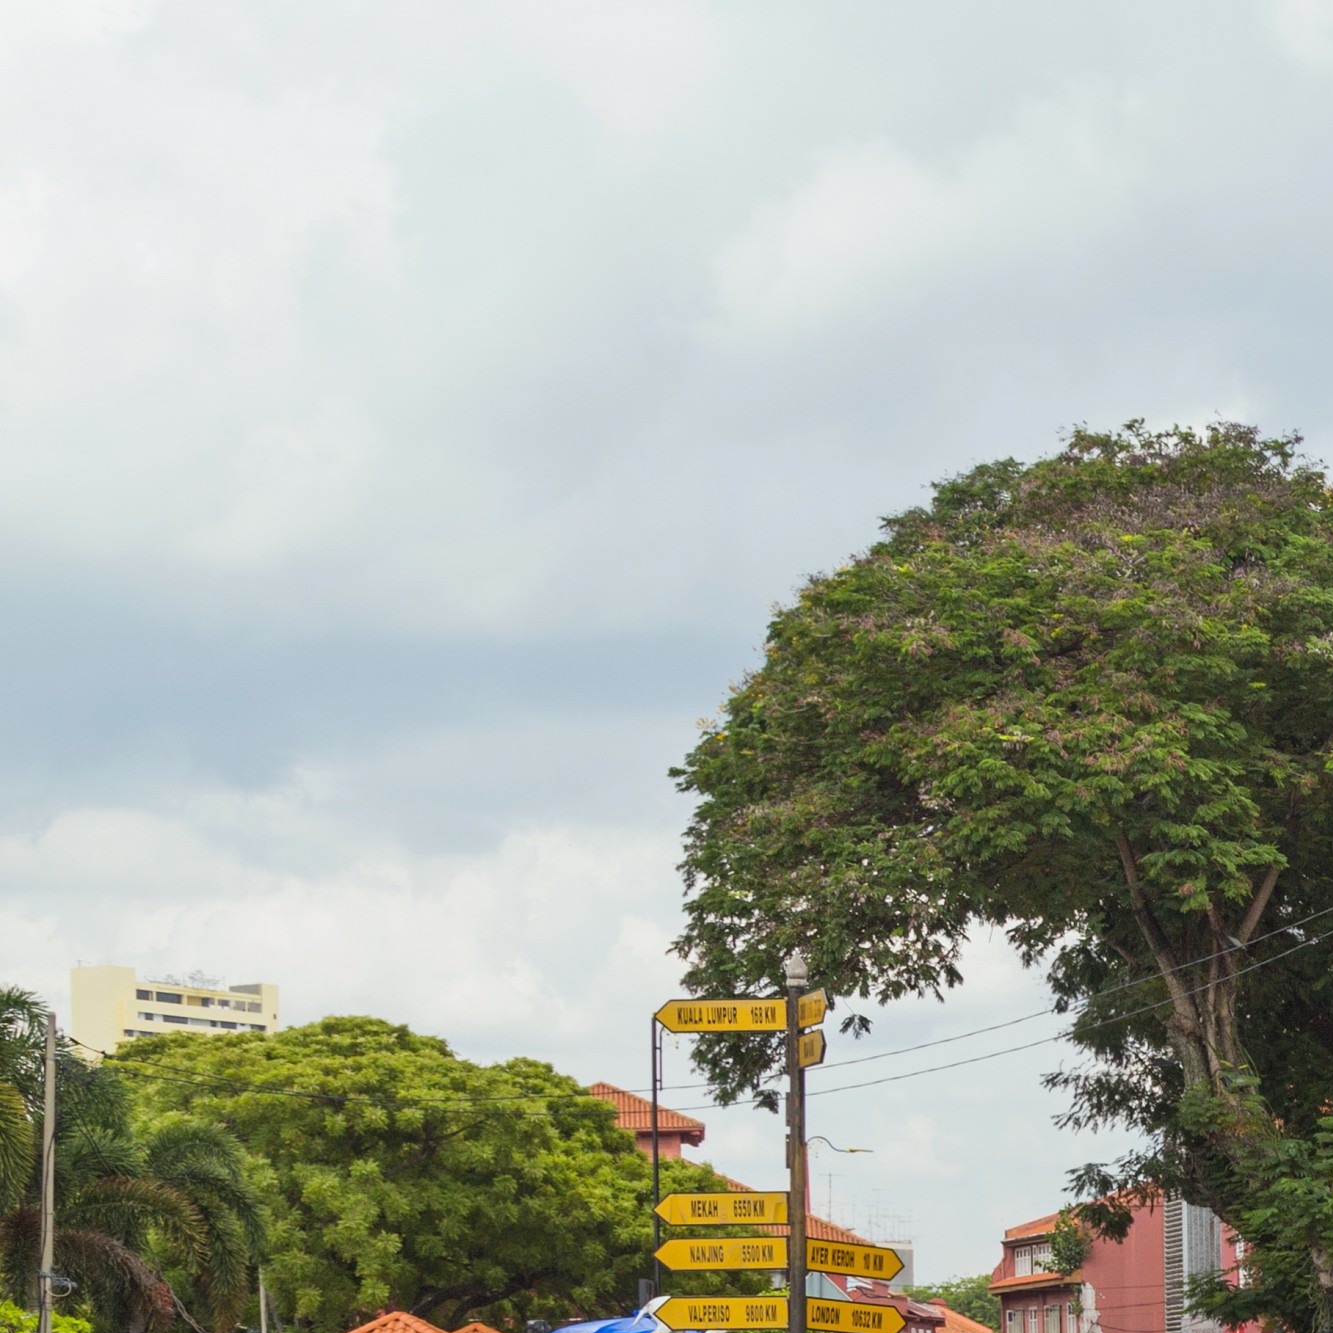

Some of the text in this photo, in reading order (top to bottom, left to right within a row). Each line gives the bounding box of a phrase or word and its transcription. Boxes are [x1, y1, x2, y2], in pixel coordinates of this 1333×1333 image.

[677, 1006, 777, 1024] KUALA LUMPUR 168 KM
[691, 1200, 765, 1217] MEKAH 6550 KM
[690, 1245, 774, 1263] NANJING 5500 KM
[811, 1247, 884, 1271] AYER KEROH 10 KM
[688, 1305, 778, 1322] VALPERISO 9800 KM
[811, 1305, 883, 1329] LONDON 10632 KM
